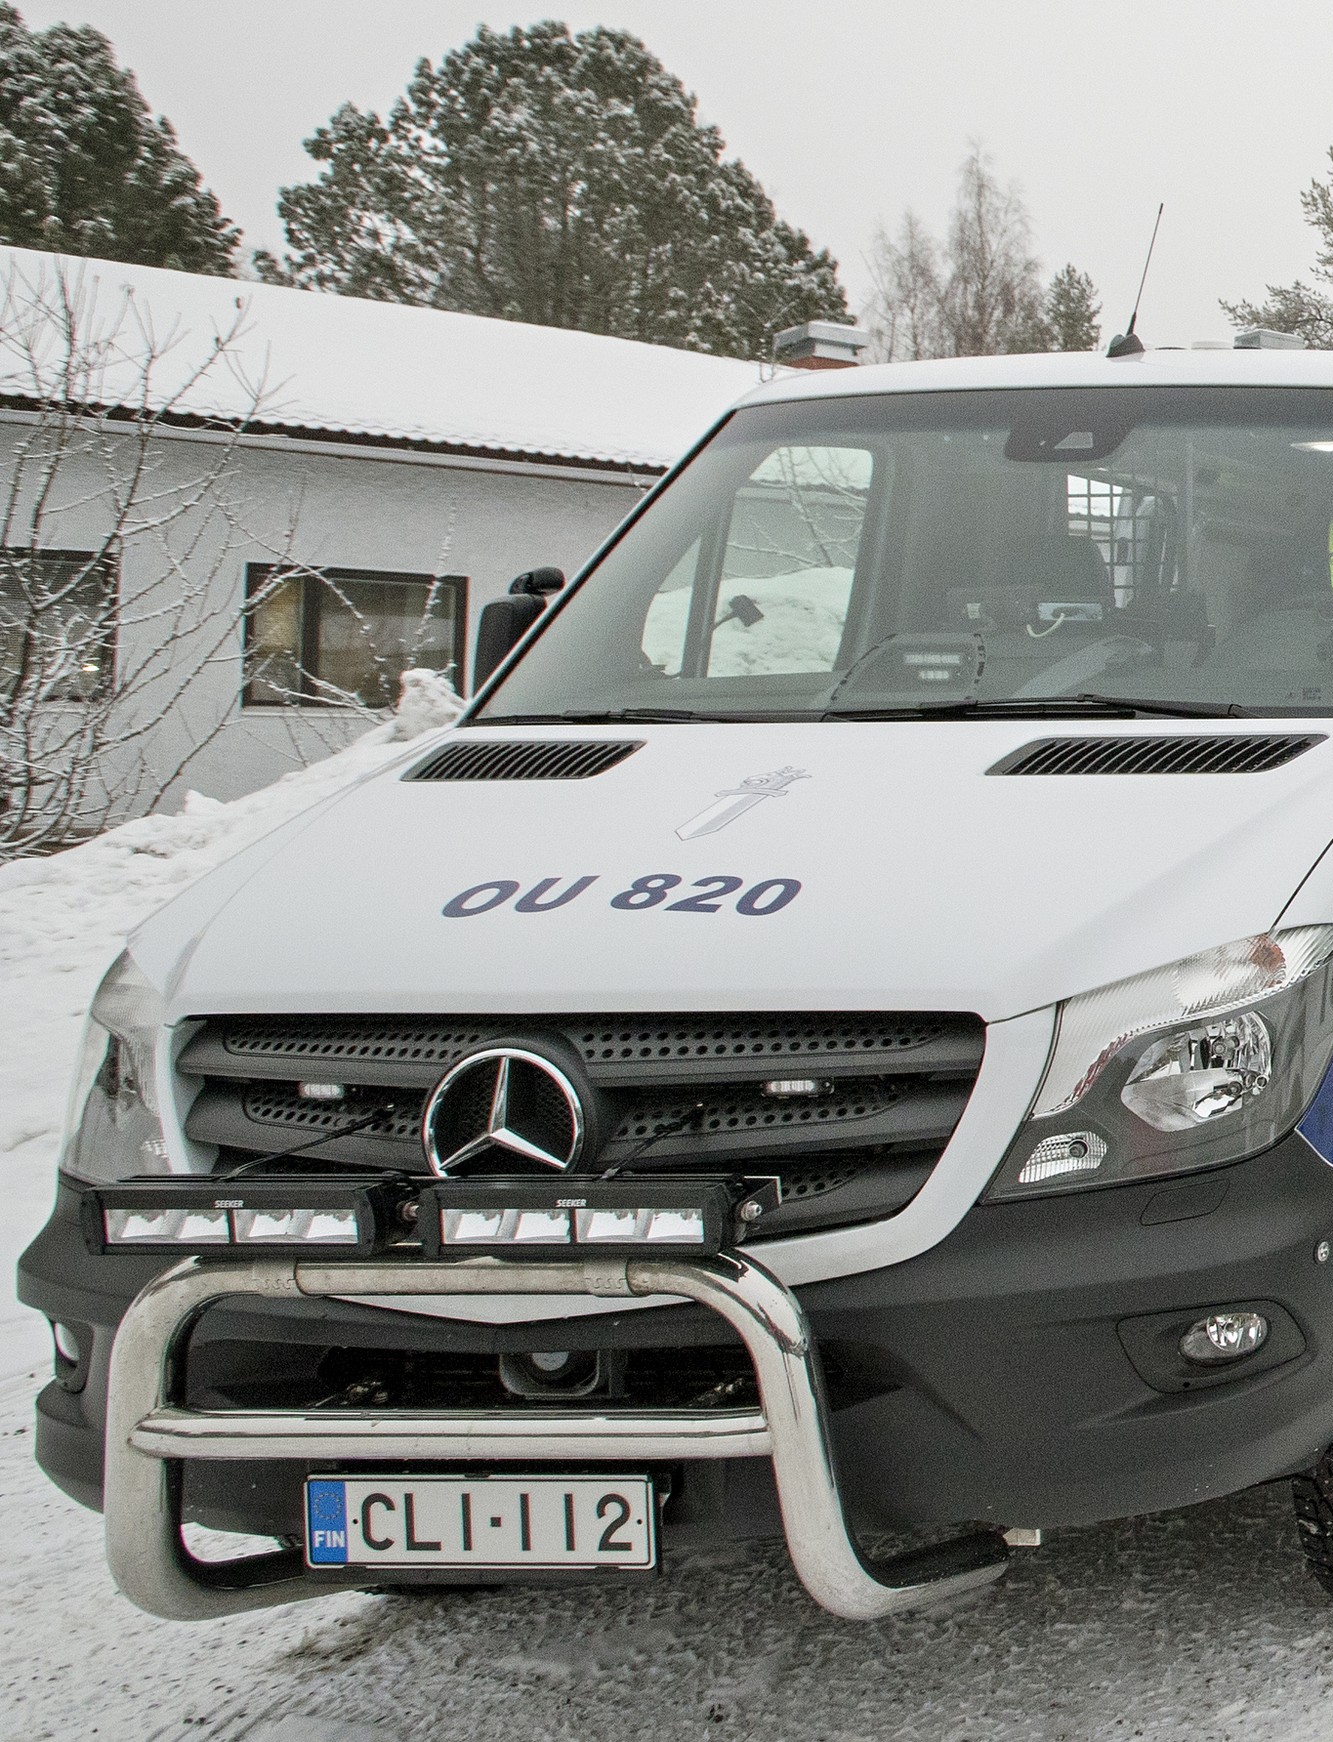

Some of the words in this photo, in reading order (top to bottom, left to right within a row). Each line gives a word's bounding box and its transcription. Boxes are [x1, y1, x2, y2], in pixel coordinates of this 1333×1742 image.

[441, 875, 601, 918] OU
[610, 873, 803, 916] 820
[213, 1200, 245, 1209] SEEKER
[555, 1199, 587, 1208] SEEKER
[361, 1492, 633, 1552] CLI-112
[313, 1530, 345, 1548] FIN
